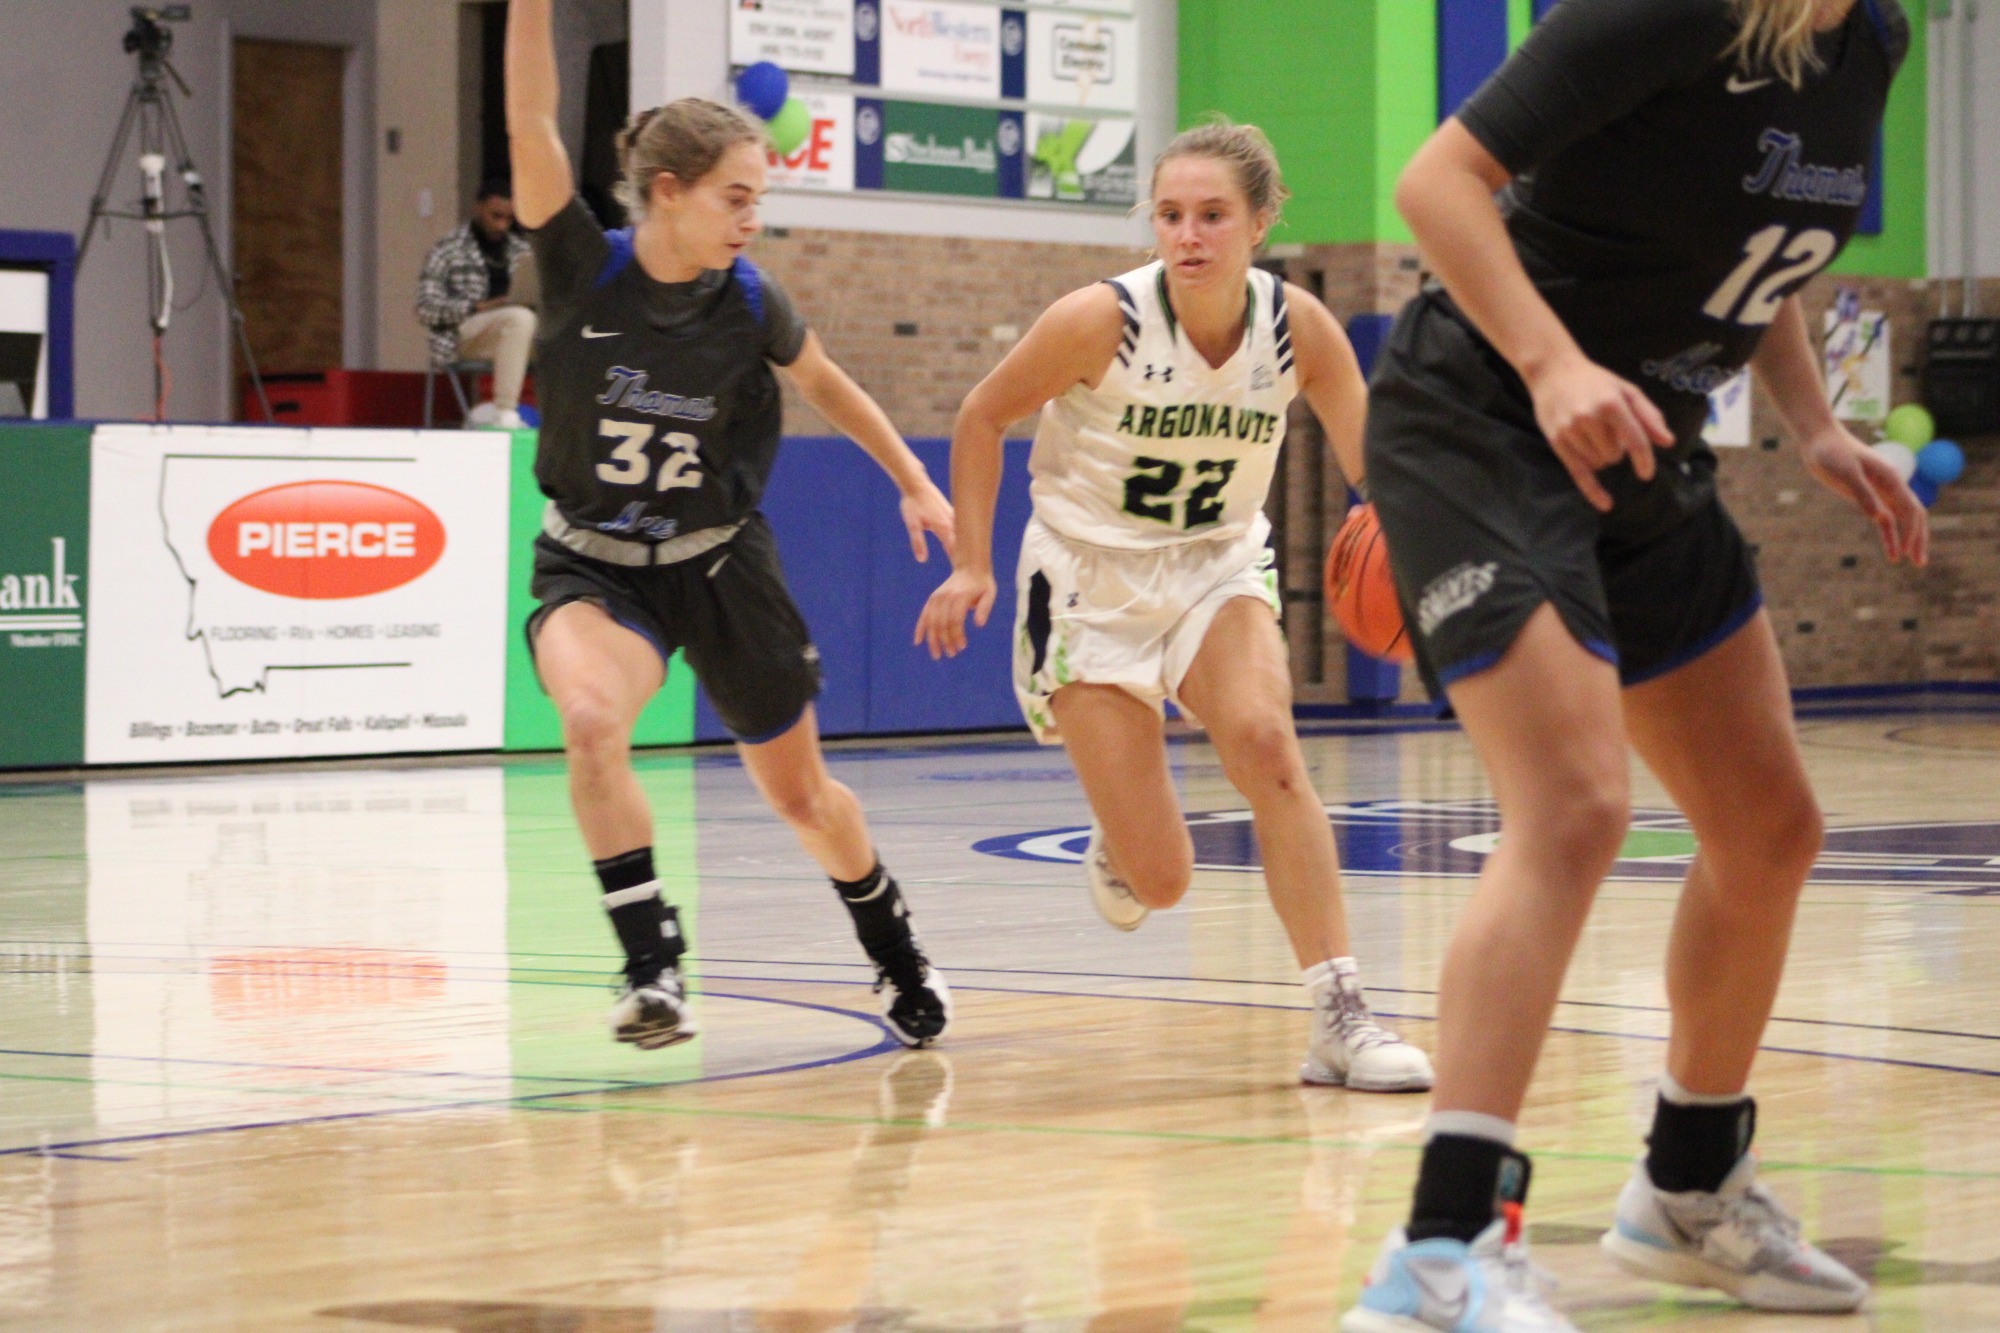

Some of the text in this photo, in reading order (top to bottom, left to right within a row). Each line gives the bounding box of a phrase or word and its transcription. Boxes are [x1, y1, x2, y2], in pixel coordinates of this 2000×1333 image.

[1702, 224, 1837, 325] 12
[1117, 403, 1279, 444] ARGONAUTS
[595, 418, 705, 491] 32
[1122, 455, 1239, 530] 22
[237, 522, 416, 557] PIERCE
[210, 626, 278, 641] FLOORING
[325, 624, 374, 639] HOMES
[385, 623, 441, 638] LEASING
